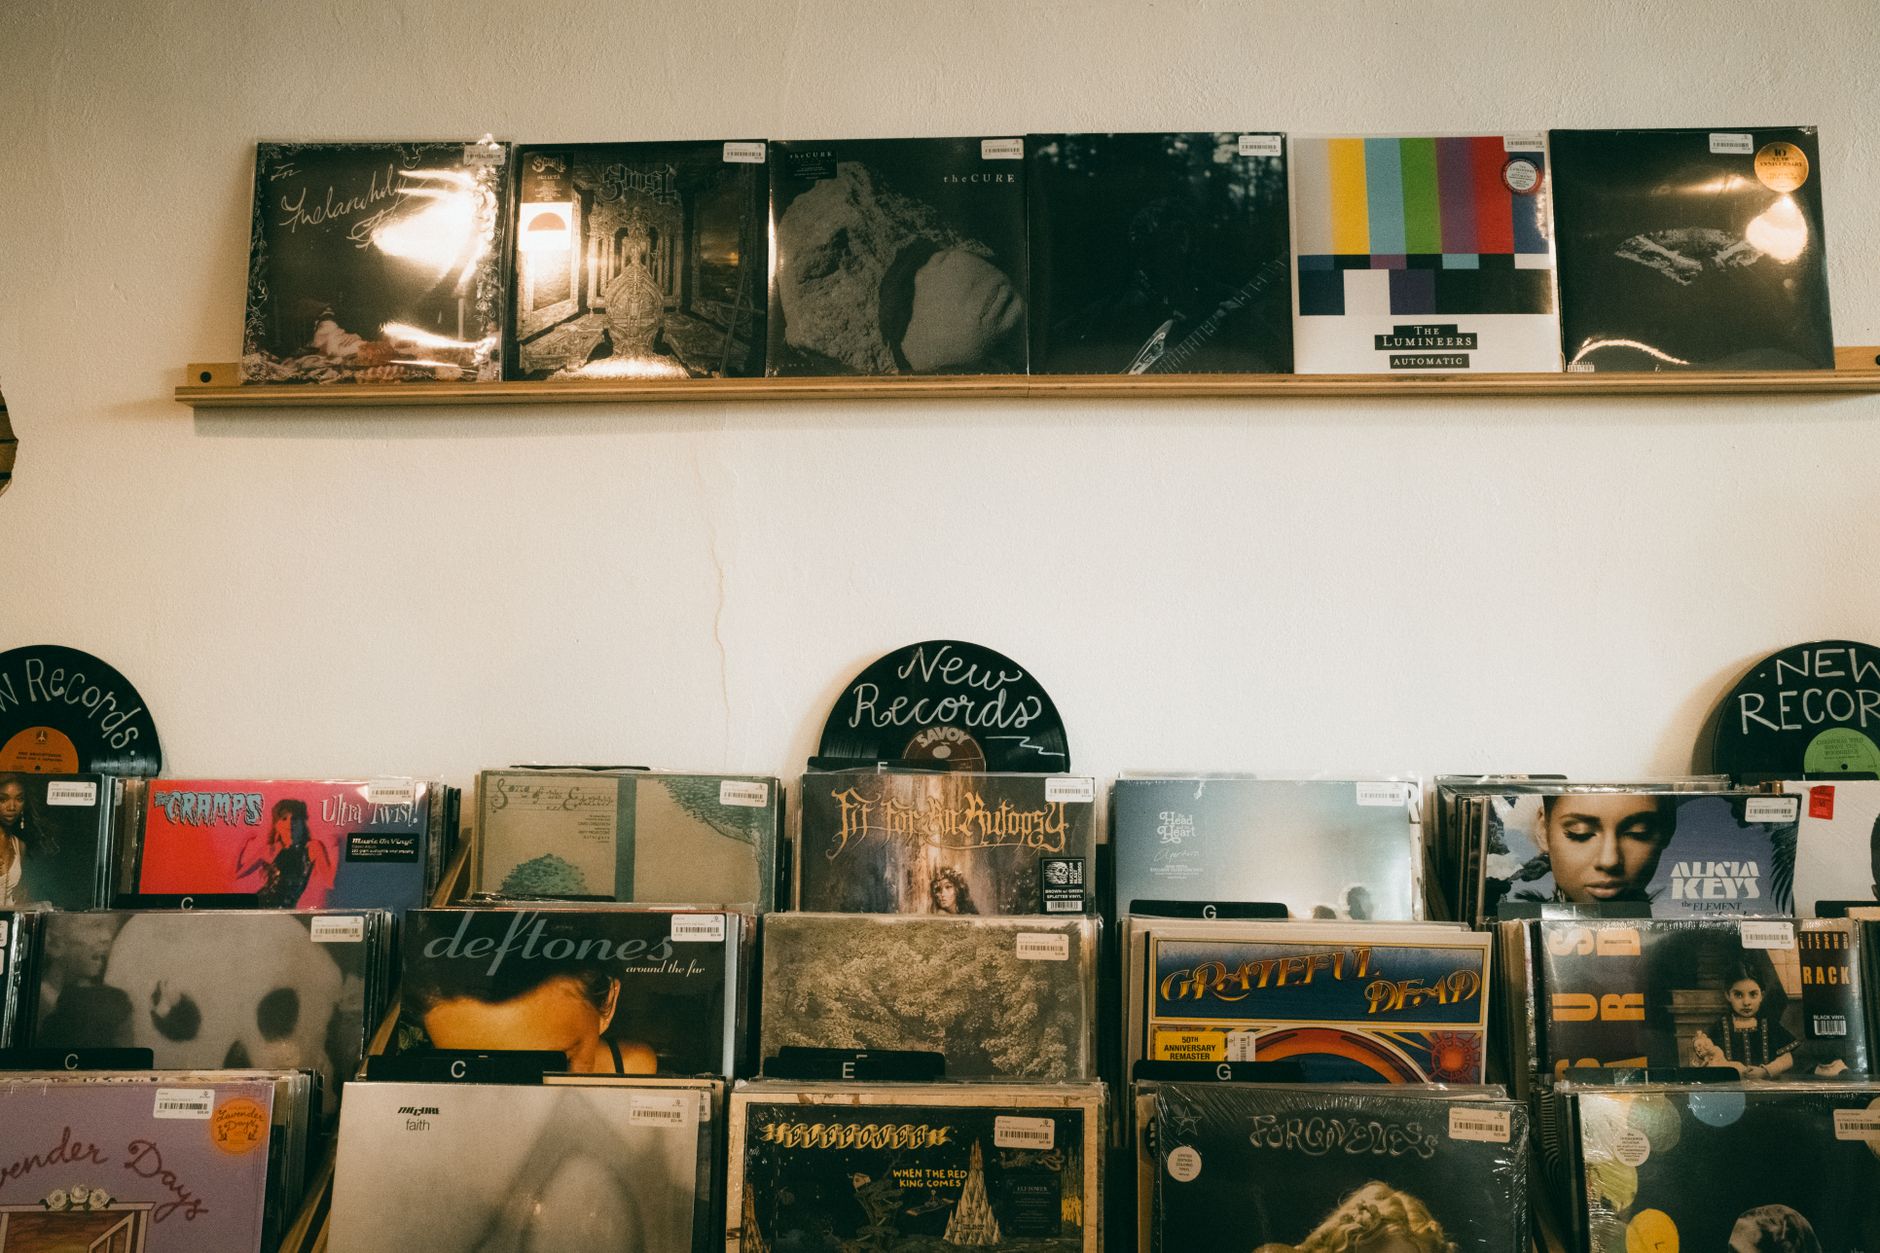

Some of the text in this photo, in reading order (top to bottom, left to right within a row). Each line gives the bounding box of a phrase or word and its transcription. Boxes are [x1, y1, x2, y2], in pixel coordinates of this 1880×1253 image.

[1382, 335, 1473, 348] LUMINEERS
[1393, 356, 1463, 367] AUTOMATIC
[898, 645, 1022, 691] New
[1776, 648, 1880, 686] NEW
[848, 683, 1043, 729] Records
[916, 726, 971, 749] SAVOY
[163, 790, 264, 827] CRAMPS
[320, 793, 363, 828] Ultra
[958, 791, 1069, 853] Autopsy
[1159, 811, 1193, 825] Head
[1671, 860, 1760, 878] ALICIA
[1670, 877, 1761, 900] KEYS
[1202, 904, 1217, 920] G
[423, 911, 675, 977] deftones
[625, 958, 706, 977] around the fur
[1160, 946, 1381, 1001] GRATEFUL
[1802, 965, 1850, 985] RACK
[1363, 969, 1481, 1014] DEAD
[1163, 1044, 1217, 1052] ANNIVERSARY
[1181, 1036, 1199, 1044] 50TH
[64, 1054, 79, 1070] C
[1169, 1052, 1211, 1060] REMASTER
[450, 1061, 467, 1079] C
[841, 1062, 856, 1079] E
[1216, 1063, 1232, 1081] G
[405, 1118, 430, 1132] faith
[124, 1139, 209, 1223] Days
[893, 1168, 968, 1179] WHEN THE RED
[899, 1178, 961, 1188] KING COMES
